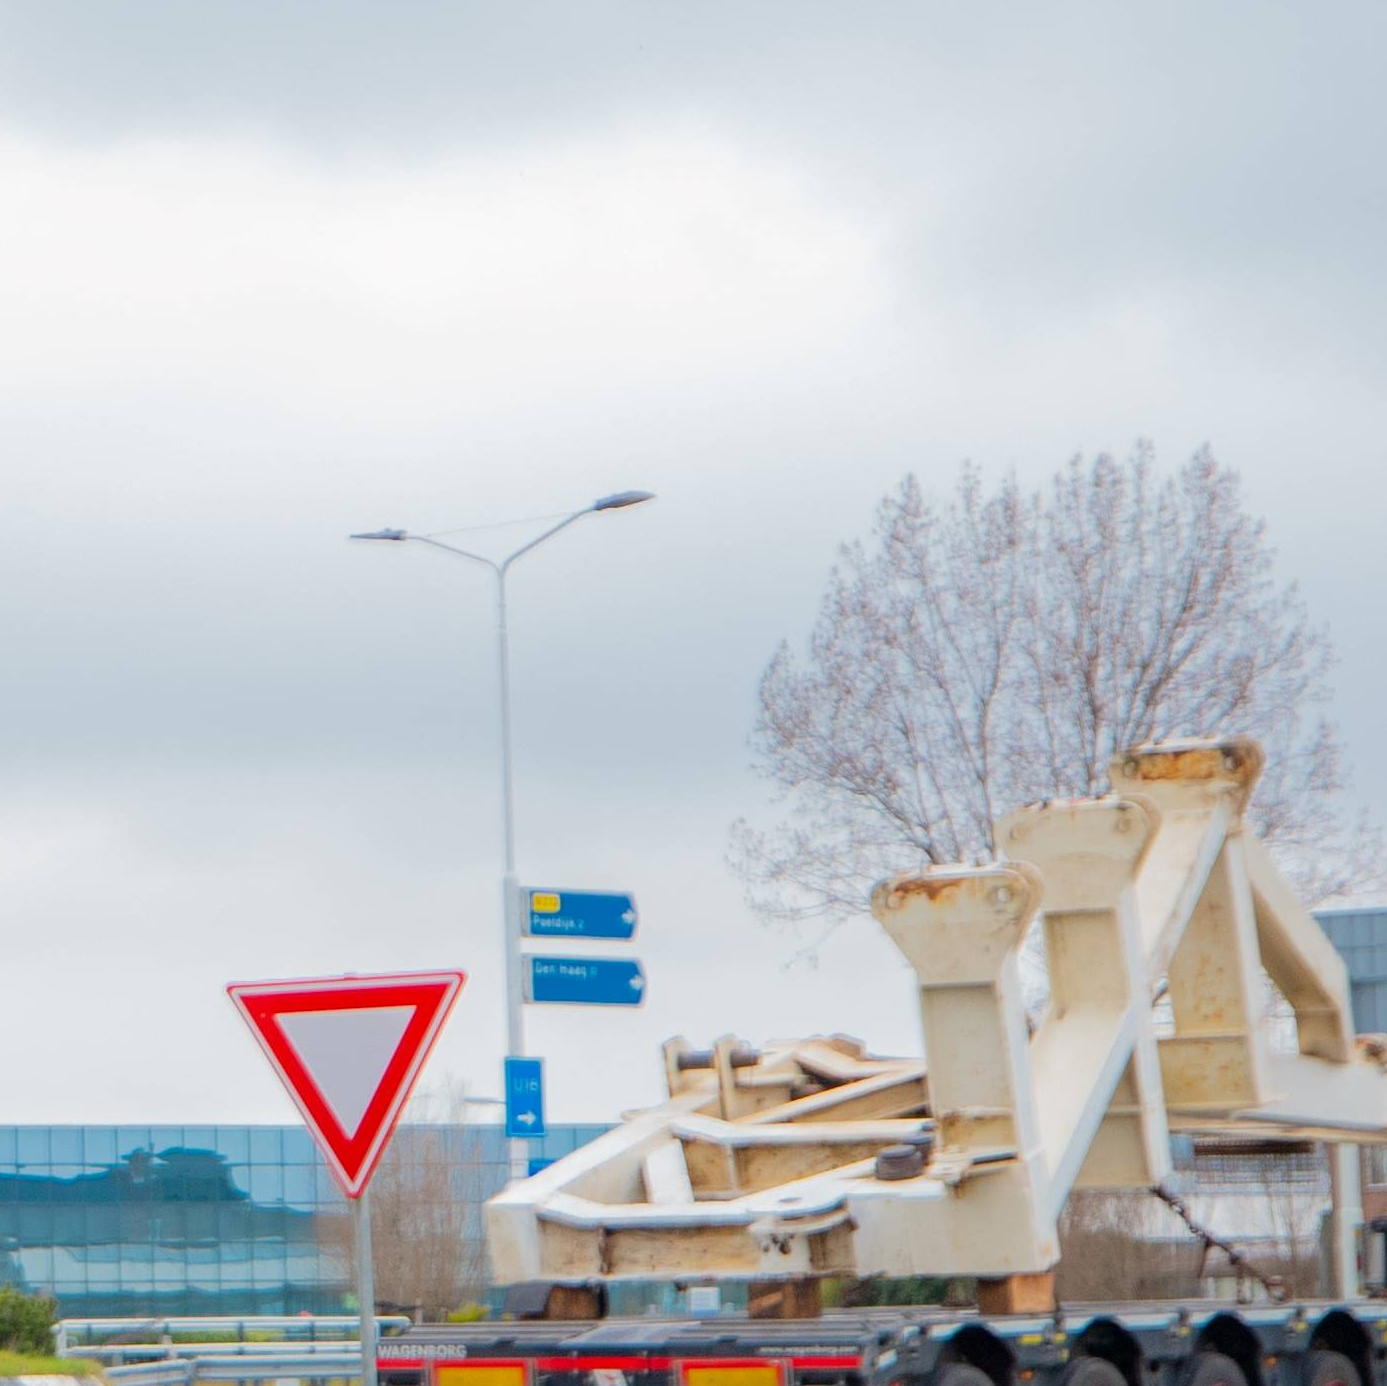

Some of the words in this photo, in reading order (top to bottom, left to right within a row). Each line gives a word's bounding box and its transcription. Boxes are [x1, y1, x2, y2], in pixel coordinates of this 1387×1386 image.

[533, 915, 575, 930] Poeldijk
[535, 961, 555, 974] Den
[559, 963, 587, 980] Haag
[378, 1344, 467, 1359] WAGENBORG
